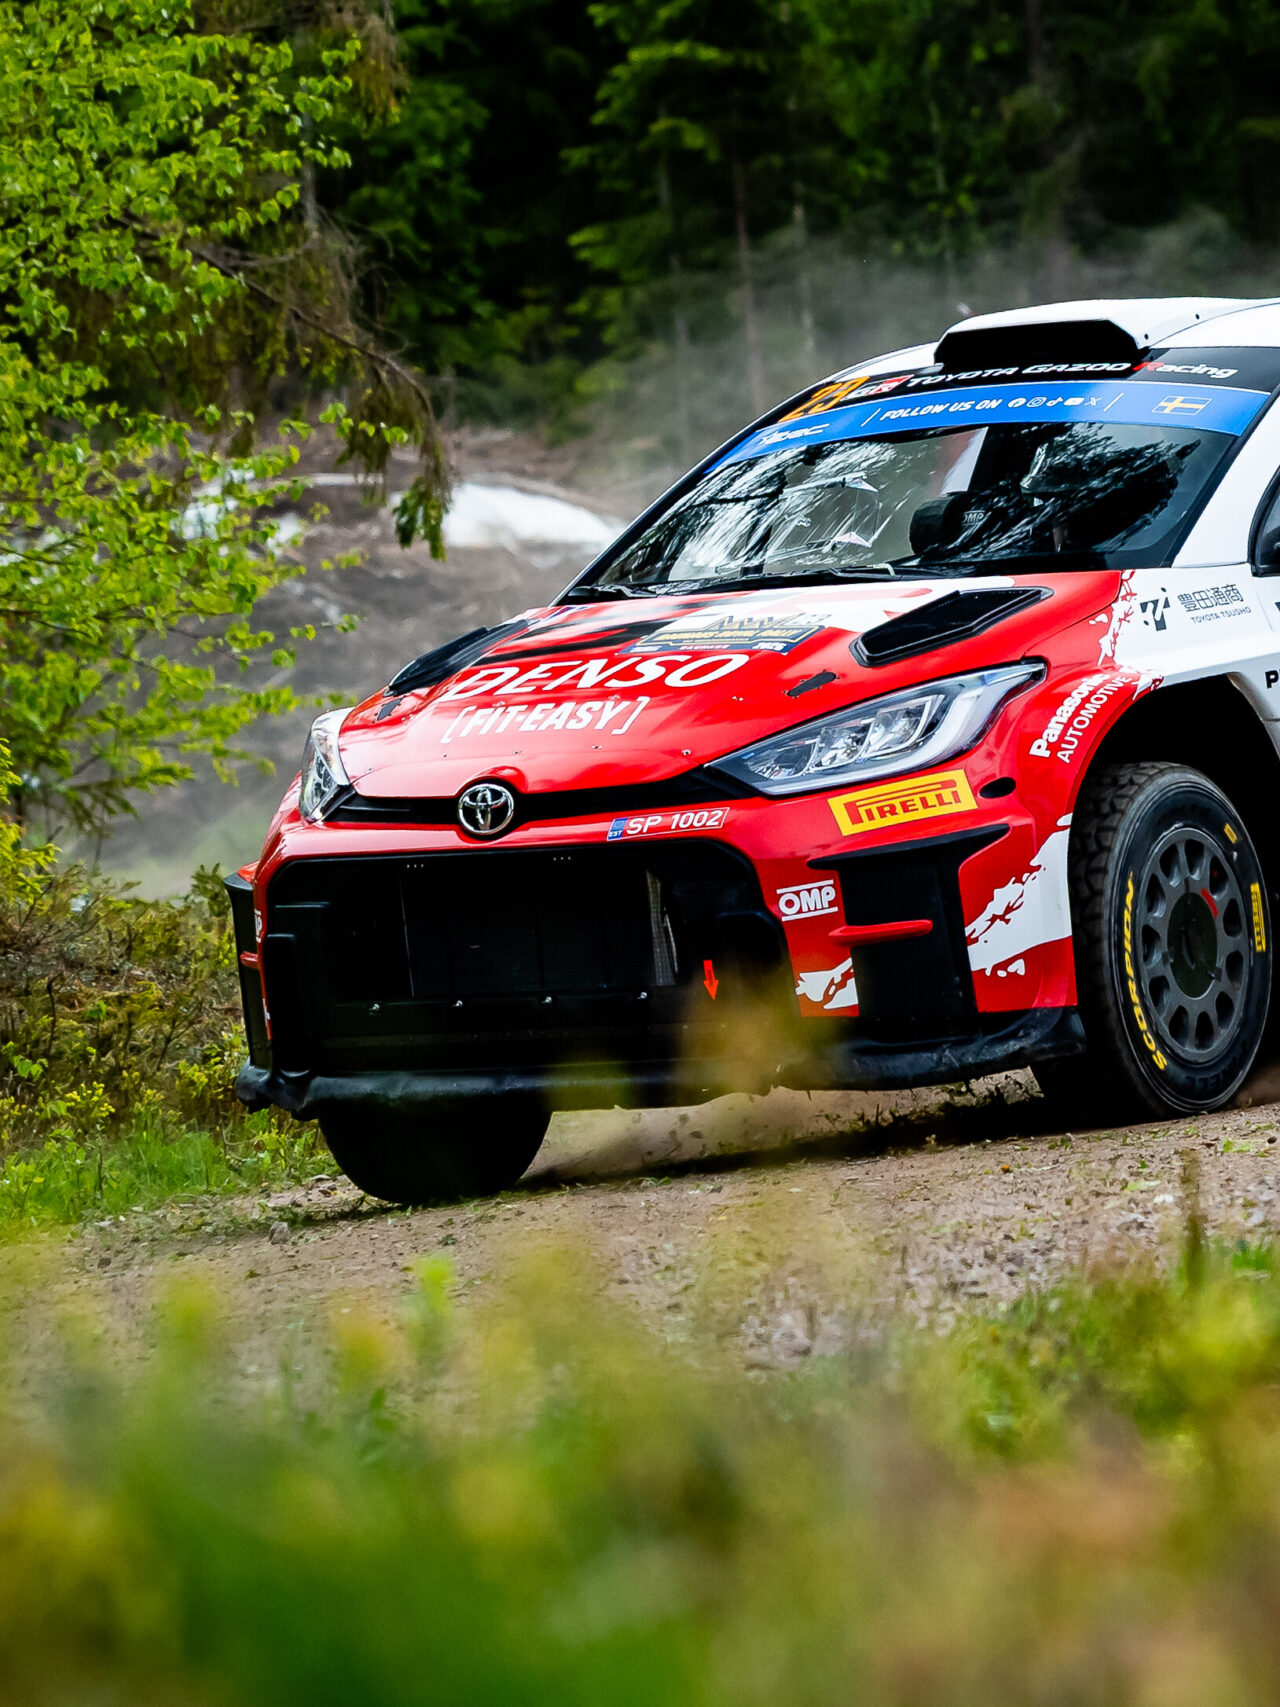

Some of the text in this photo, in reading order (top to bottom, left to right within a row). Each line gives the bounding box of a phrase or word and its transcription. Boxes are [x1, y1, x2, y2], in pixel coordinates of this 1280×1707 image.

[907, 366, 1020, 388] TOYOTA
[1022, 362, 1131, 374] GAZOO
[1133, 361, 1239, 379] Racing
[778, 376, 870, 423] 23
[879, 398, 1003, 421] FOLLOW US ON
[1190, 606, 1252, 624] TOYOTA TSUSHO
[440, 654, 750, 701] DENSO
[1029, 672, 1111, 758] Panasonic
[1056, 676, 1132, 763] AUTOMOTIVE
[626, 815, 663, 835] SP
[671, 810, 723, 830] 1002
[843, 779, 962, 826] PIRELLI
[779, 887, 836, 916] OMP
[1123, 871, 1168, 1071] SCORPION
